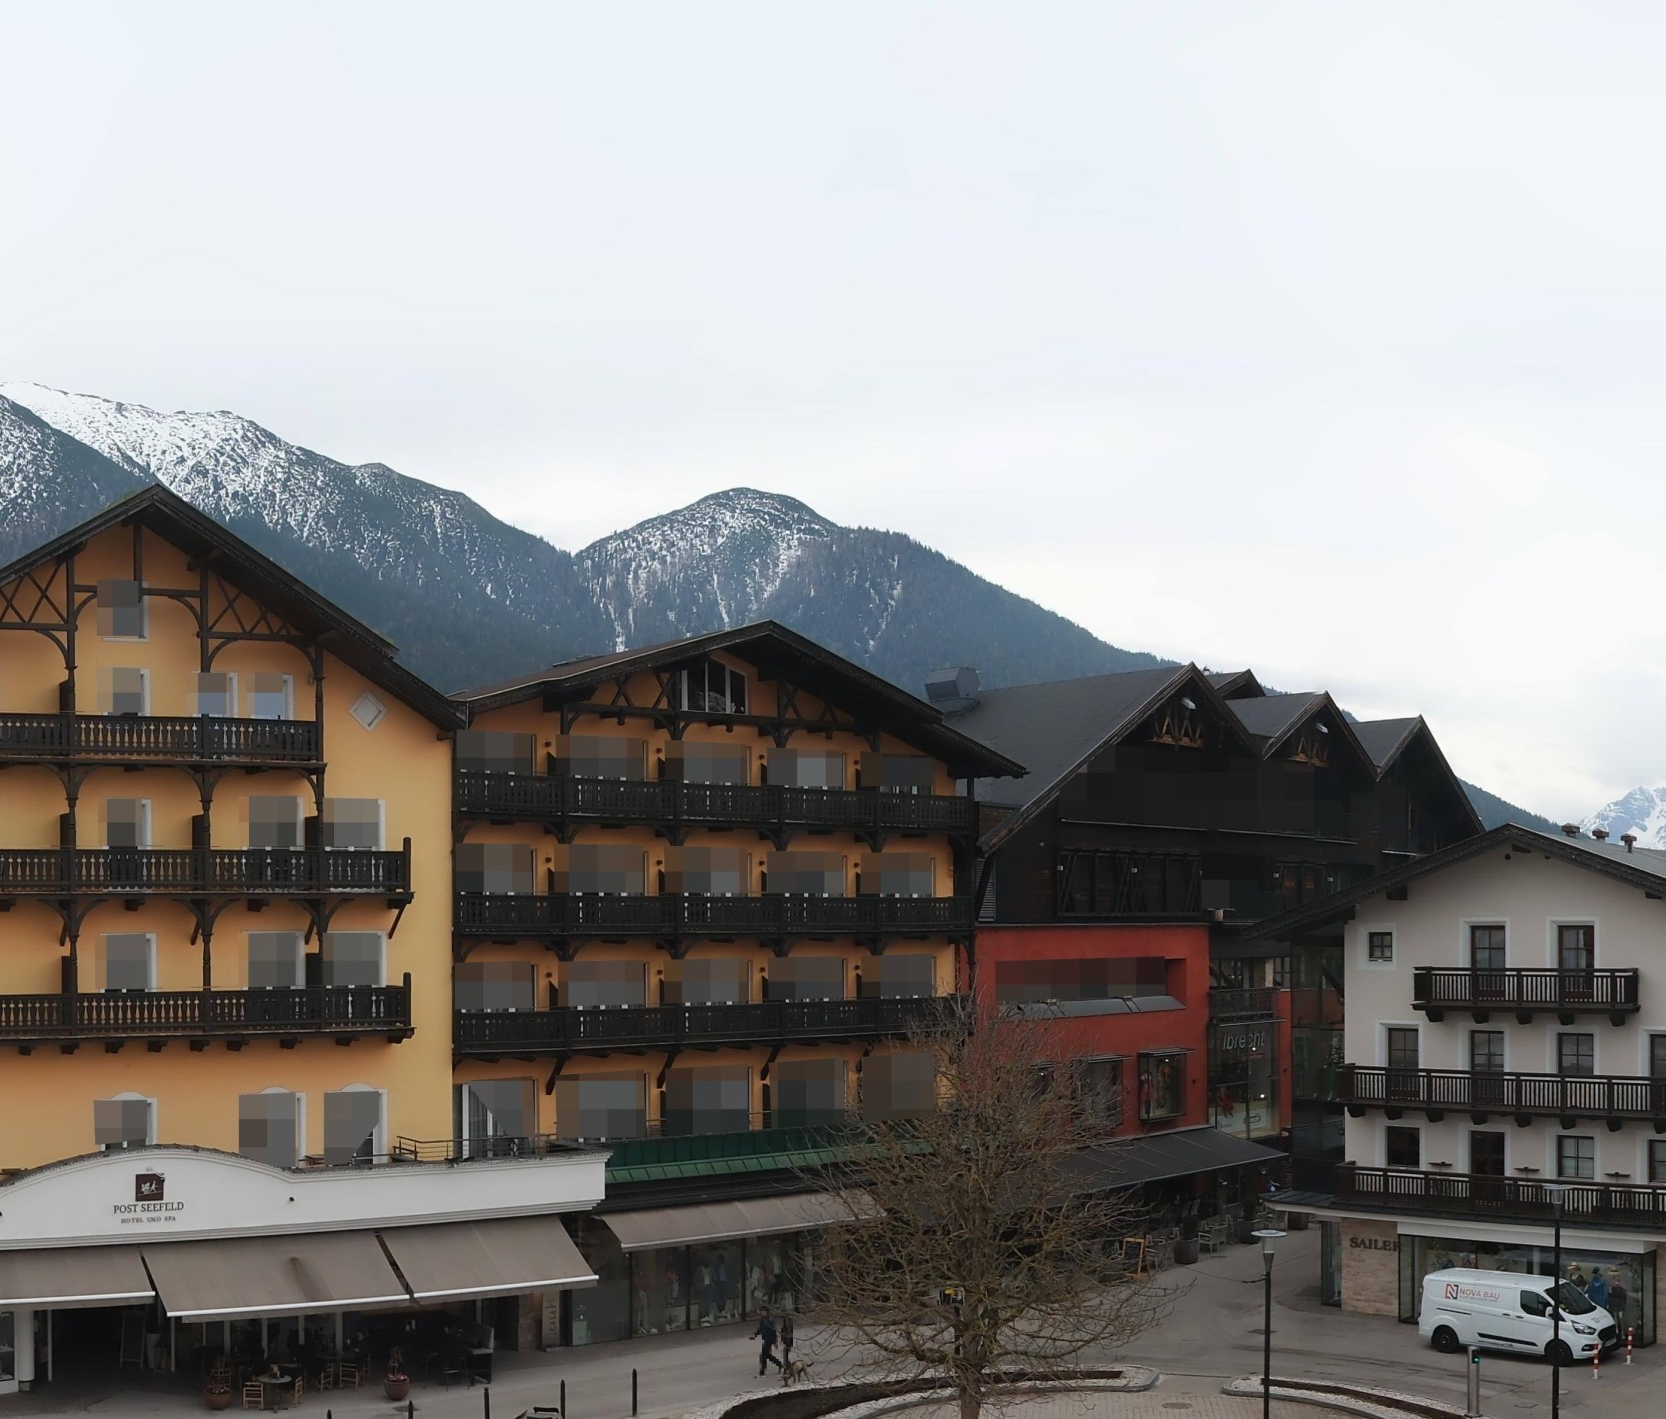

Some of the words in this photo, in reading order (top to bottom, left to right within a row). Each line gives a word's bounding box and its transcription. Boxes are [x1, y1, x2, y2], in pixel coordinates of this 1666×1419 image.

[113, 1203, 138, 1214] POST
[140, 1201, 184, 1213] SEEFELD
[1460, 1288, 1482, 1297] NOVA
[1483, 1291, 1500, 1300] BAU
